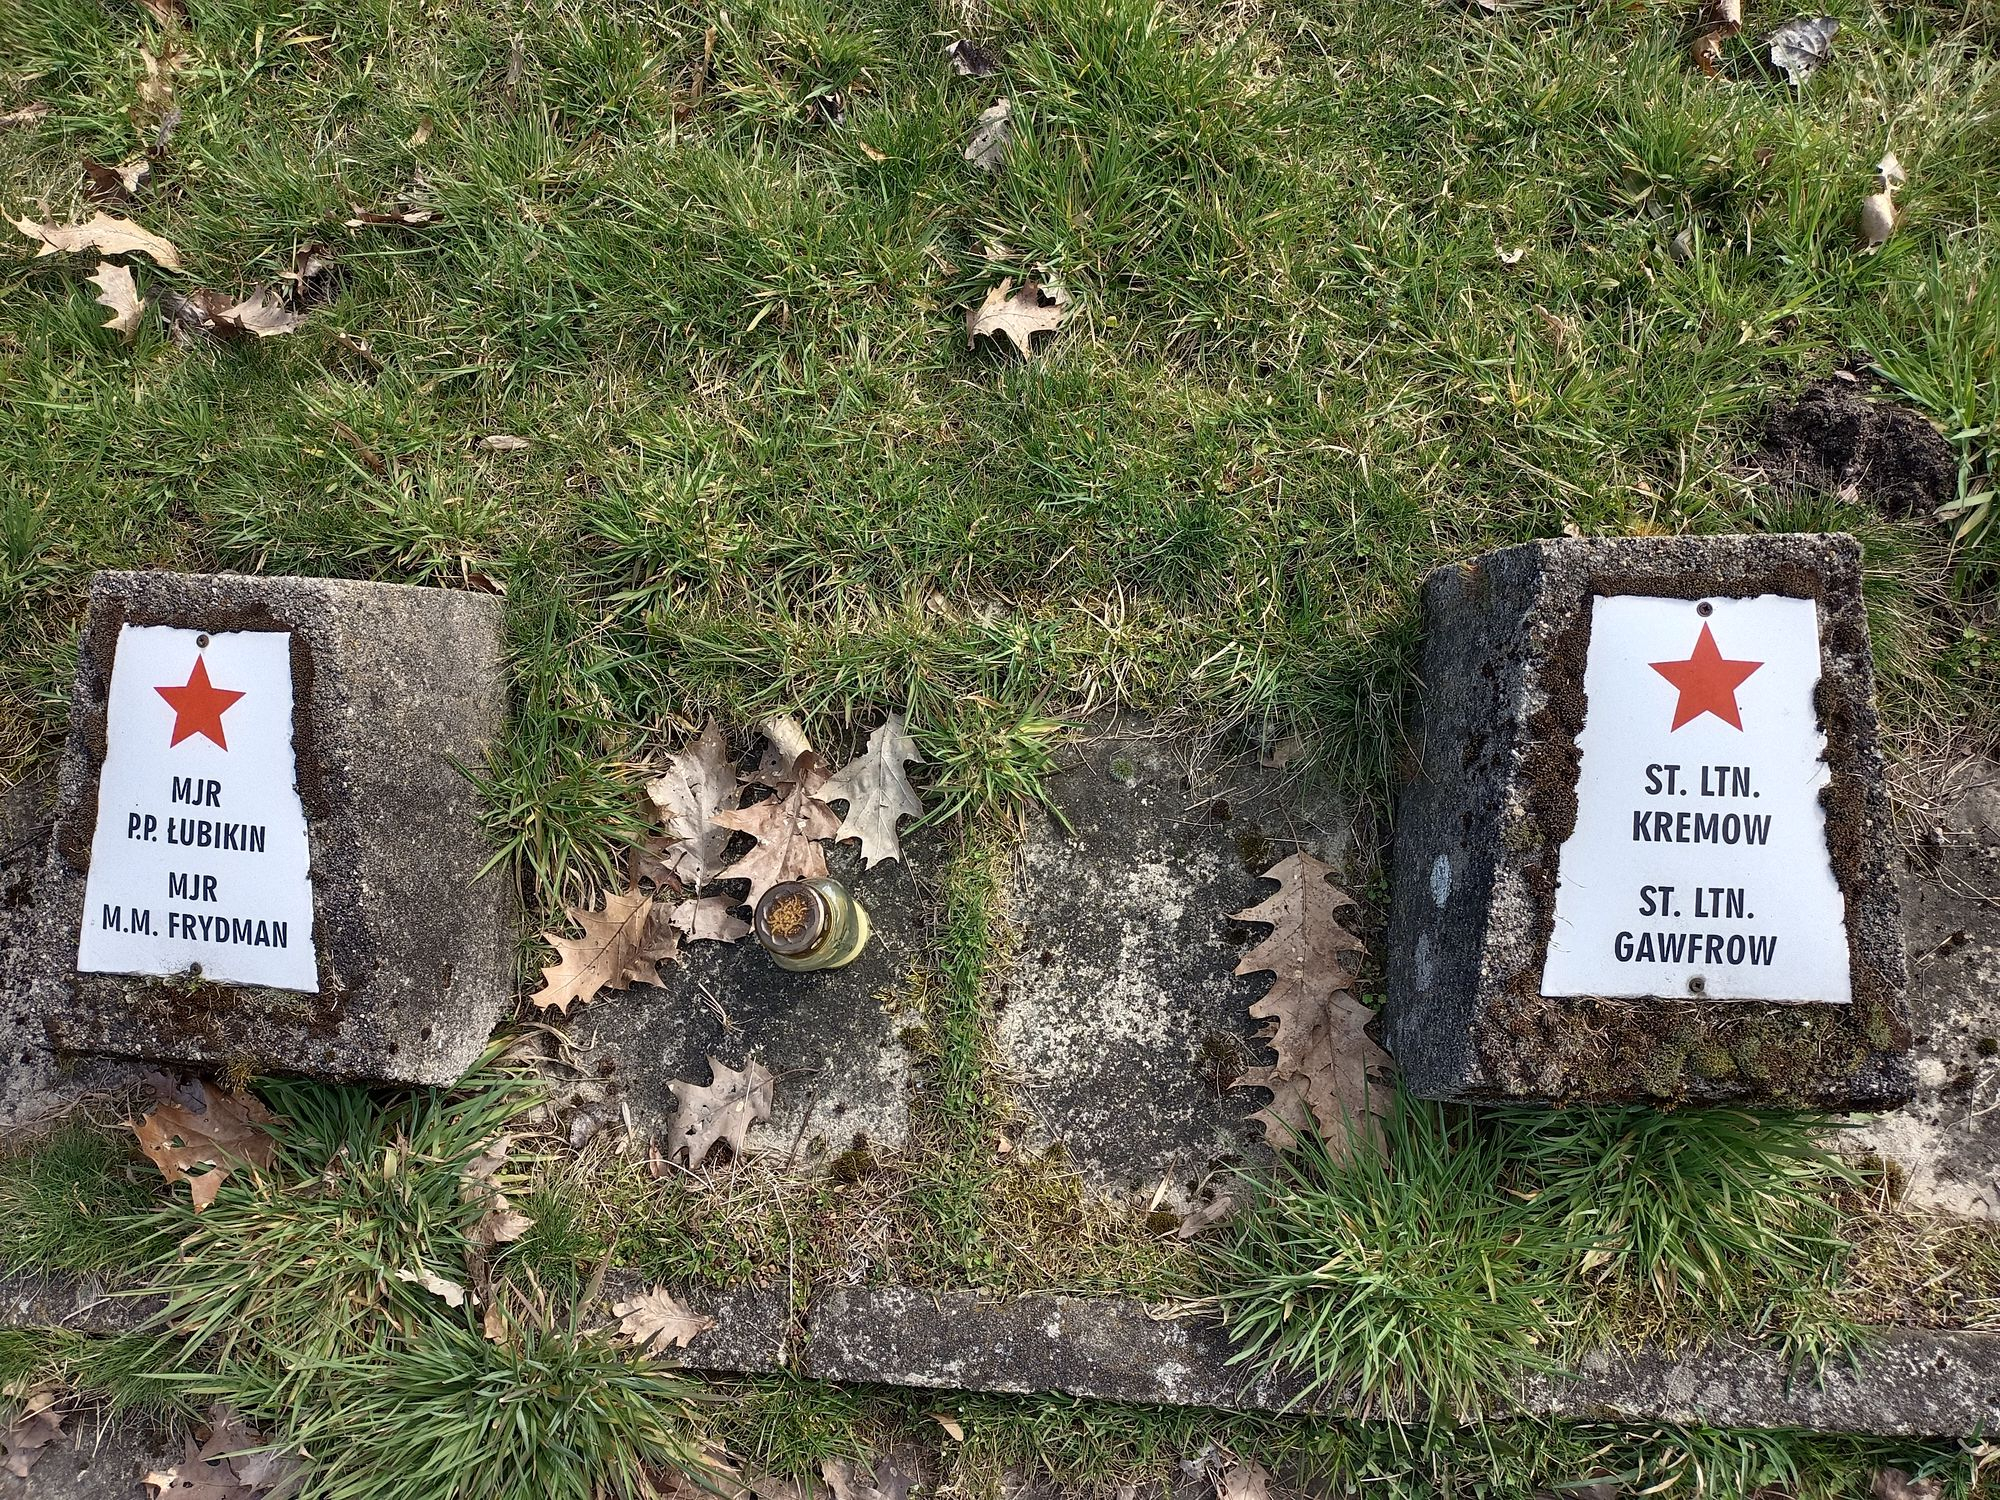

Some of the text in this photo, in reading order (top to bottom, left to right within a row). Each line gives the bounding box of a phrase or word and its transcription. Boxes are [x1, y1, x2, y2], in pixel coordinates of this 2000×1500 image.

[171, 775, 222, 808] MJR
[1644, 763, 1760, 799] ST. LTN.
[127, 812, 266, 853] P.P. ŁUBIKIN
[1632, 810, 1772, 846] KREMOW
[168, 871, 218, 903] MJR
[1638, 885, 1755, 919] ST. LTN.
[102, 903, 288, 949] M.M. FRYDMAN
[1614, 931, 1778, 966] GAWFROW
